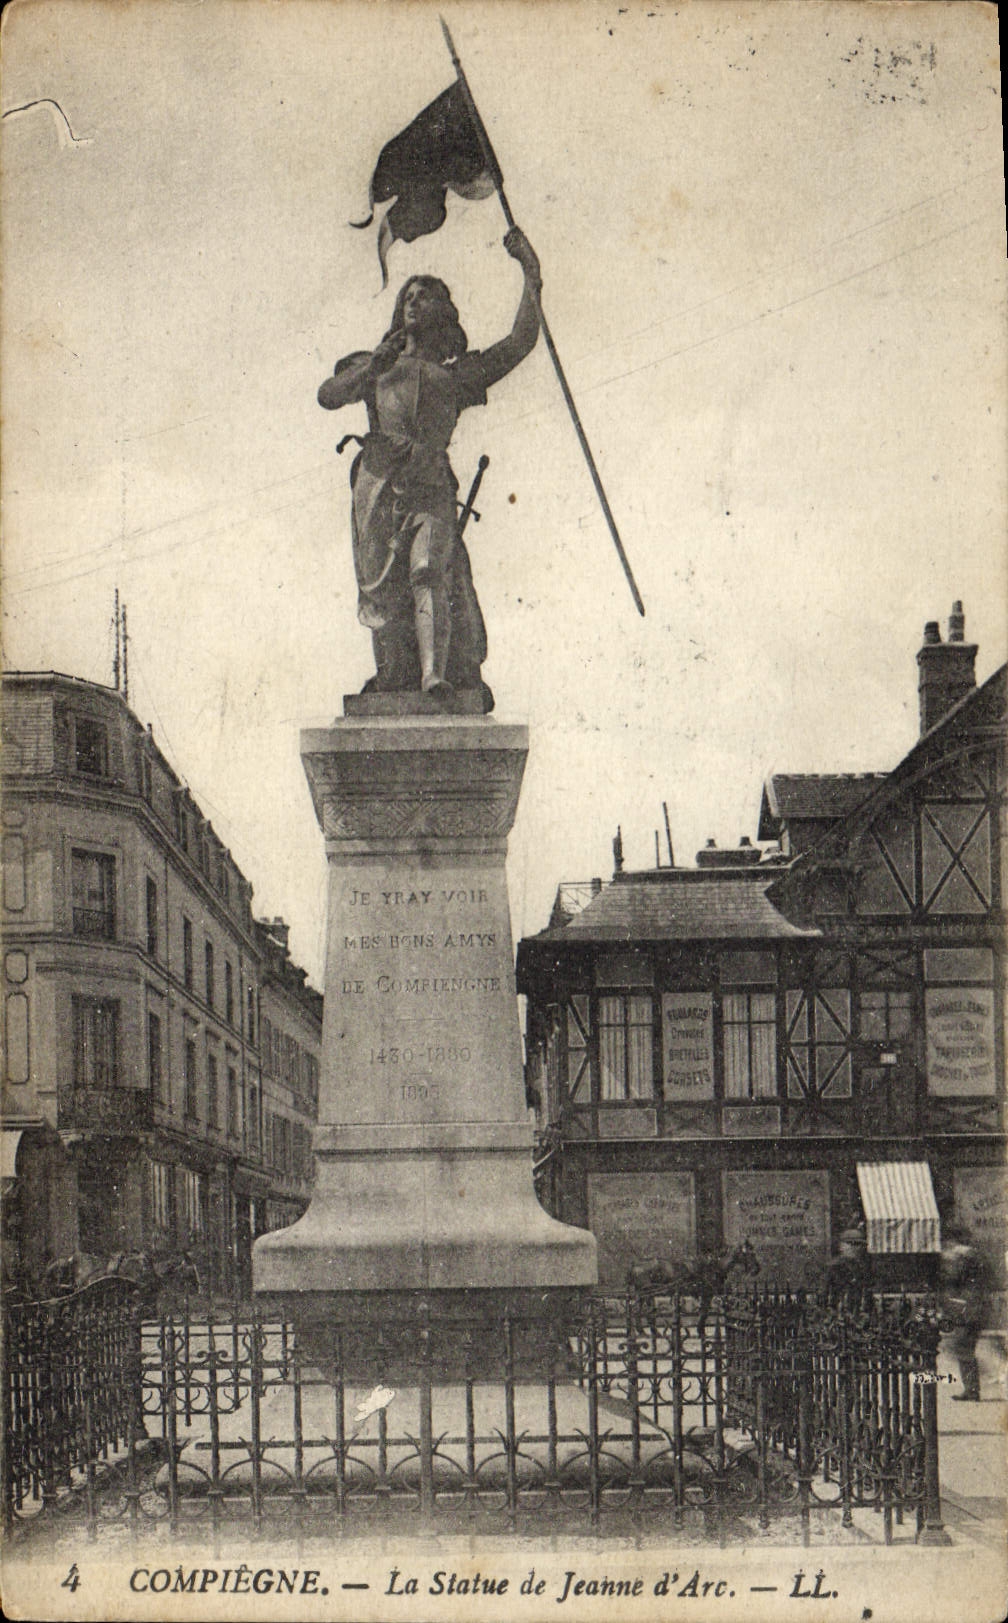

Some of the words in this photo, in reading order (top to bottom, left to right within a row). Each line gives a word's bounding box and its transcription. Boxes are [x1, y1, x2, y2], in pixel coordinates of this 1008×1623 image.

[350, 890, 370, 906] JE
[381, 891, 432, 905] YRAY
[442, 889, 488, 903] VOIR
[344, 935, 380, 949] MES
[389, 935, 434, 949] BONS
[444, 933, 496, 948] AMYS
[342, 979, 365, 994] DE
